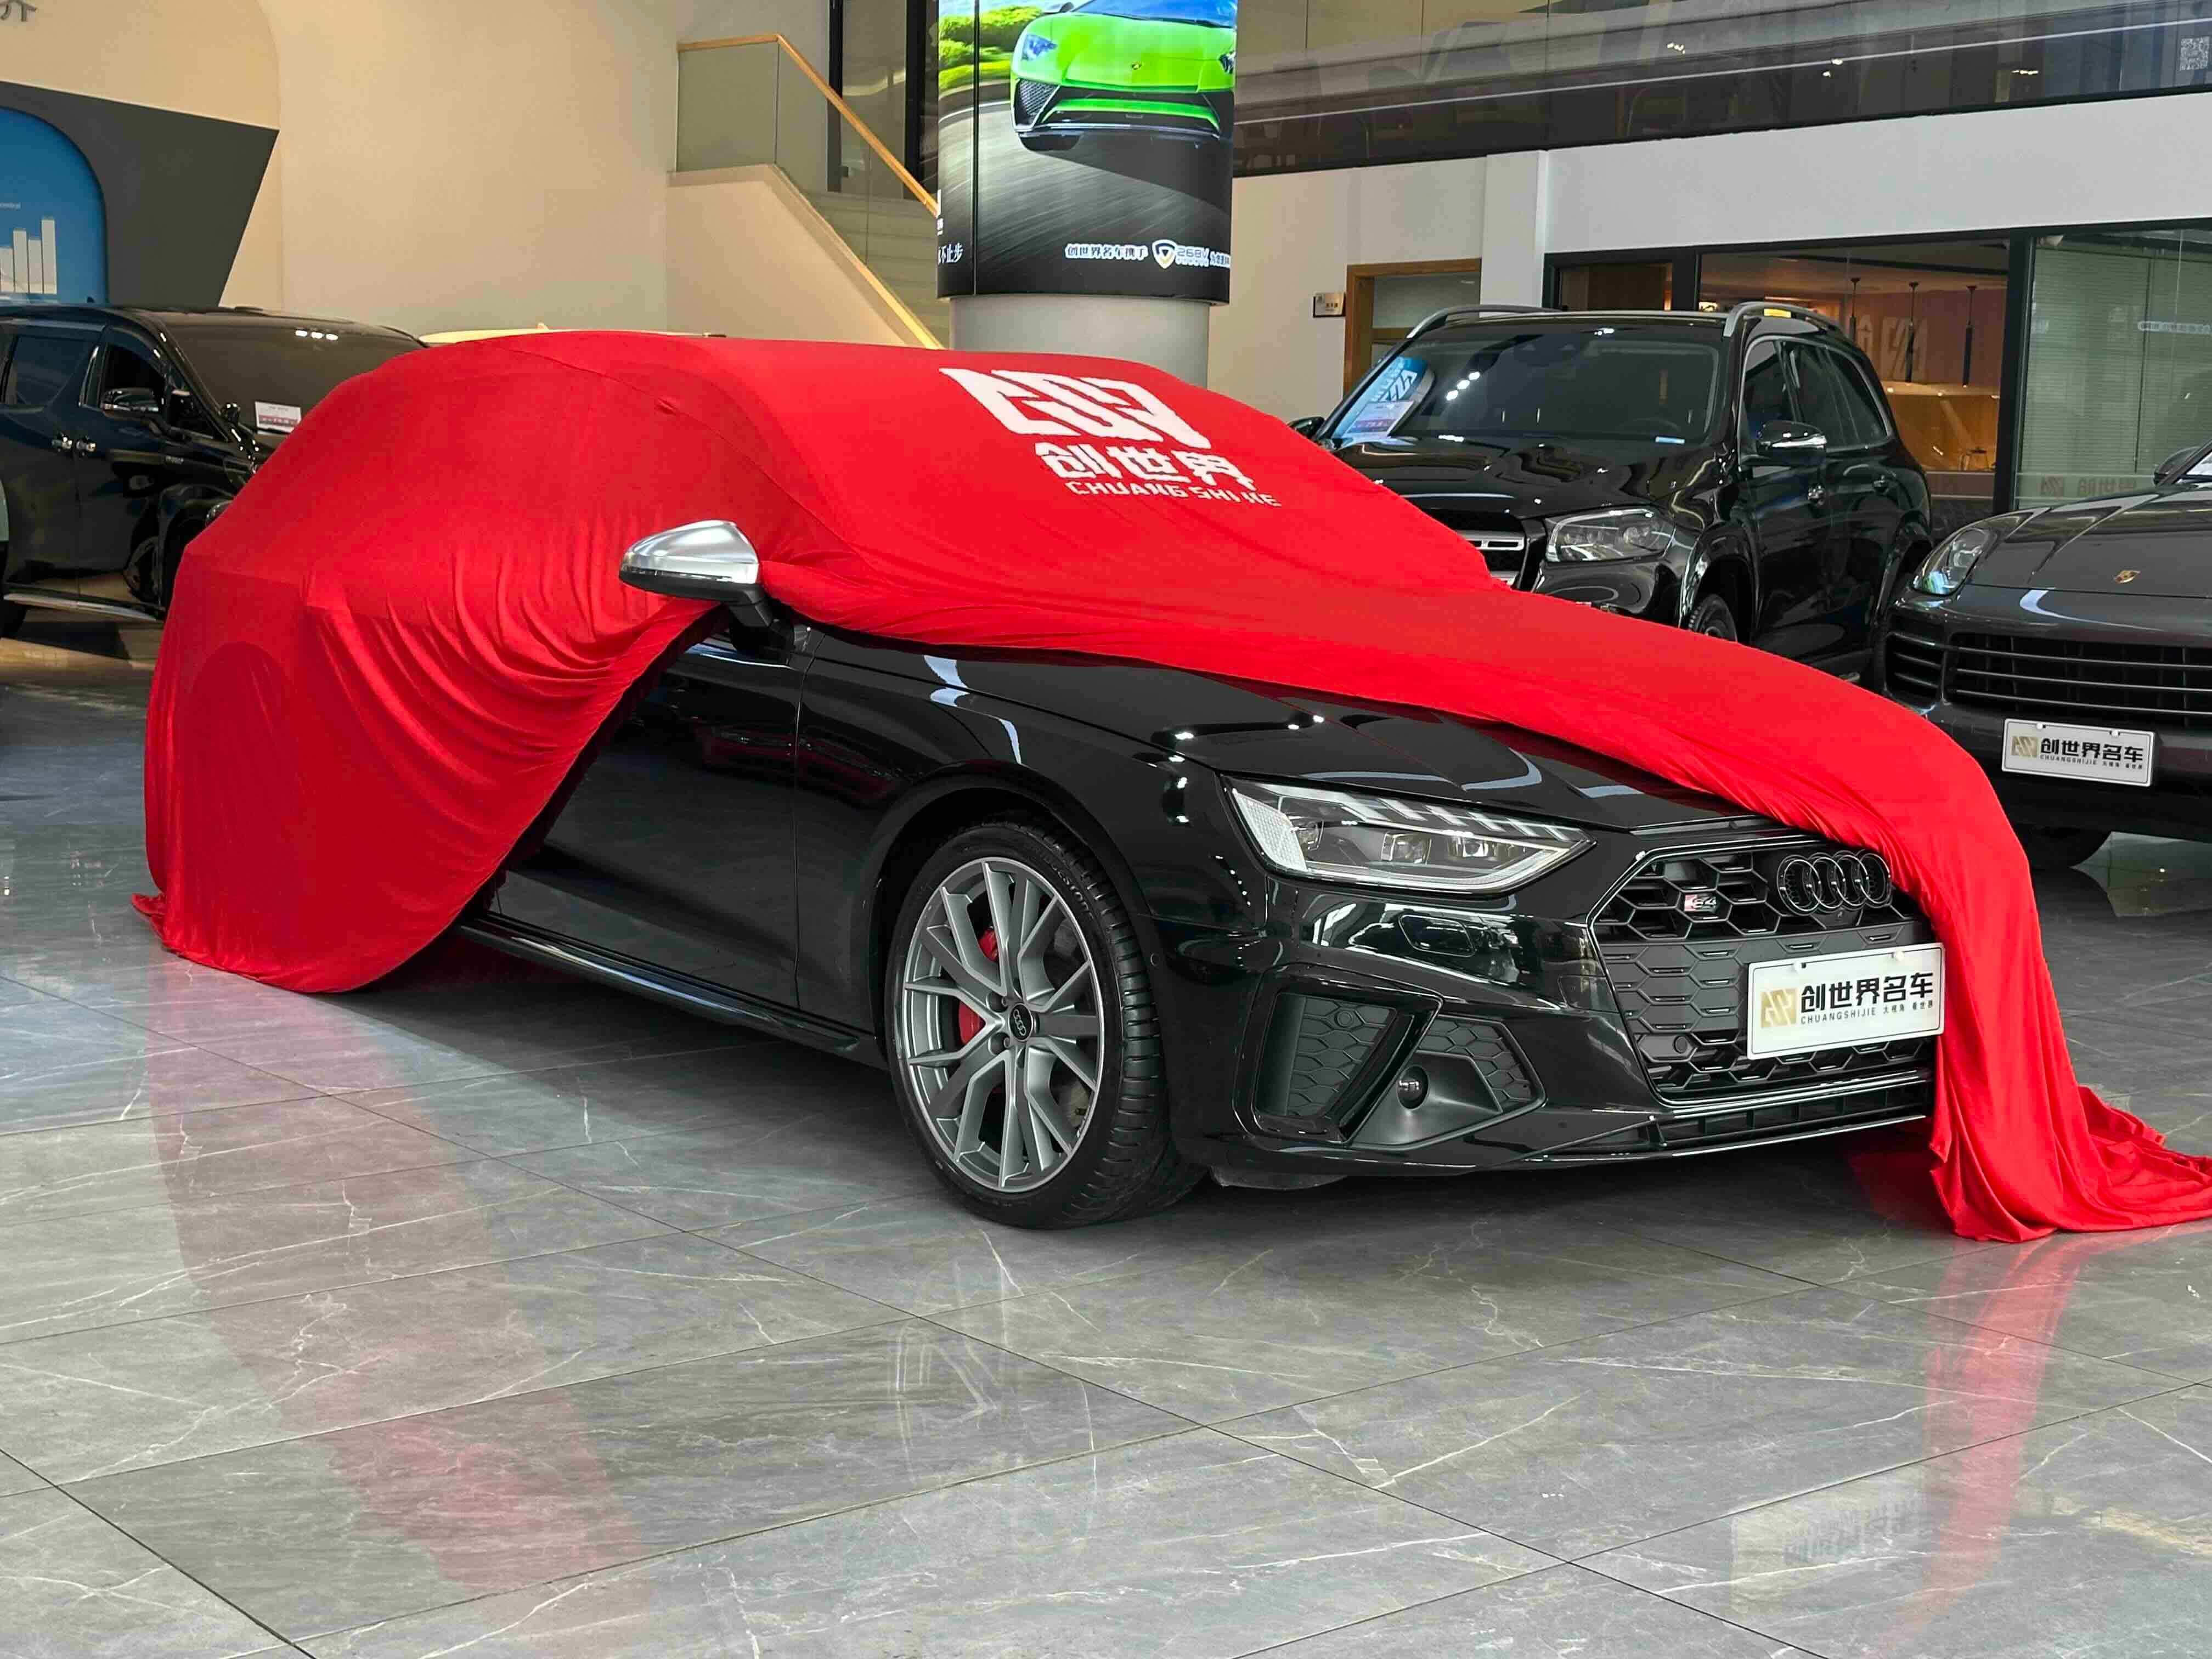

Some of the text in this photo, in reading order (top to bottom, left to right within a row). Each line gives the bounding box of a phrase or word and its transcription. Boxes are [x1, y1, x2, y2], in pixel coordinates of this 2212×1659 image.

[1035, 442, 1257, 491] 创世界
[1065, 482, 1189, 498] CHUANG
[1188, 486, 1242, 503] SHI
[2040, 738, 2143, 762] 创世界名车
[2040, 754, 2097, 765] CHUANGSHIJIE
[1801, 972, 1933, 1013] 创世界名车
[1801, 1007, 1876, 1025] CHUANGSHIJIE
